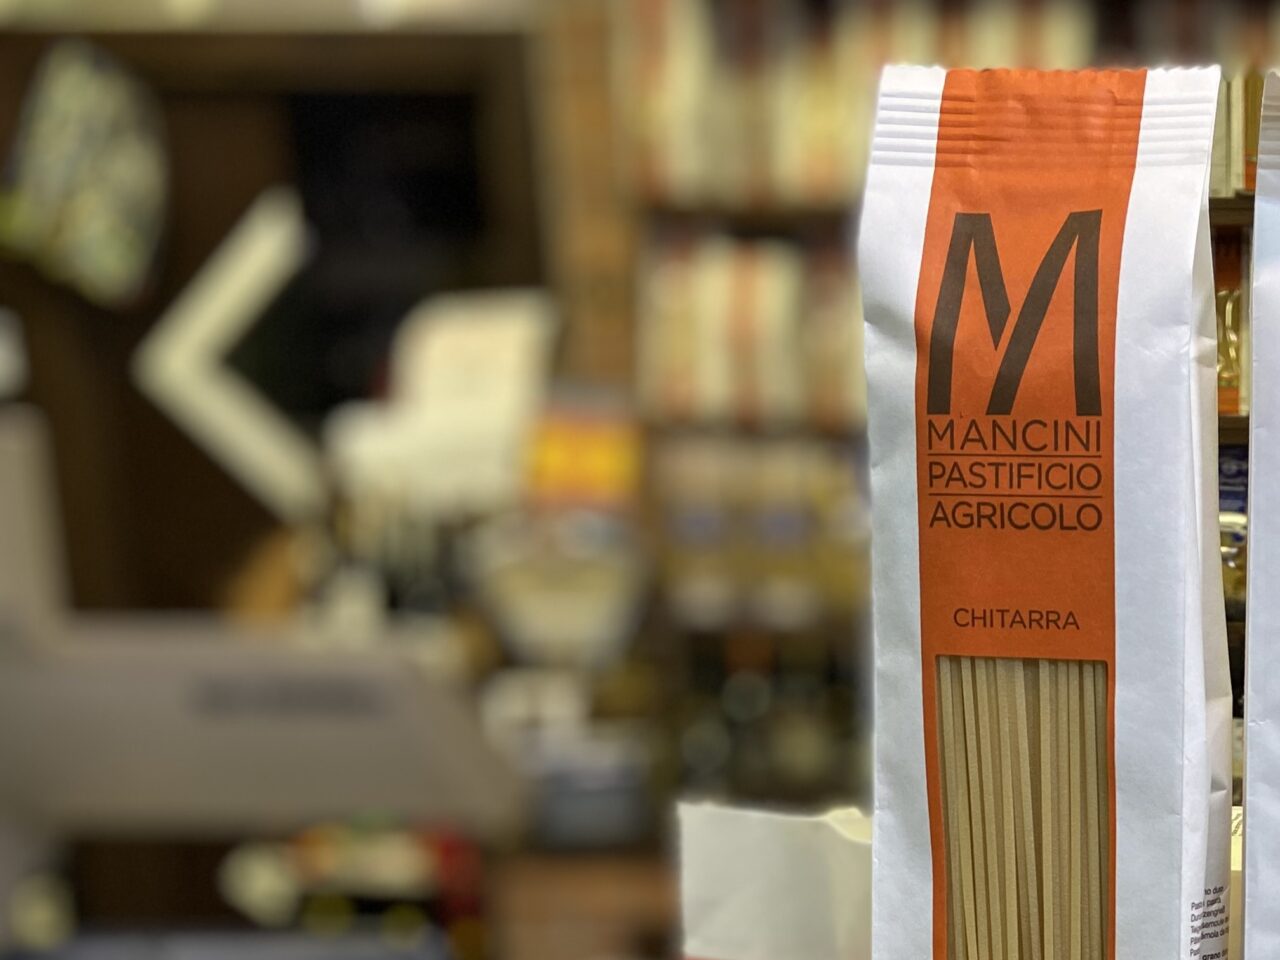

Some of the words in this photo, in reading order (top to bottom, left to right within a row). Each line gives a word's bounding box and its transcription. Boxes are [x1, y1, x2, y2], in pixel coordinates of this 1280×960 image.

[927, 419, 1101, 452] MANCINI
[928, 461, 1102, 492] PASTIFICIO
[929, 502, 1103, 531] AGRICOLO
[953, 607, 1080, 631] CHITARRA
